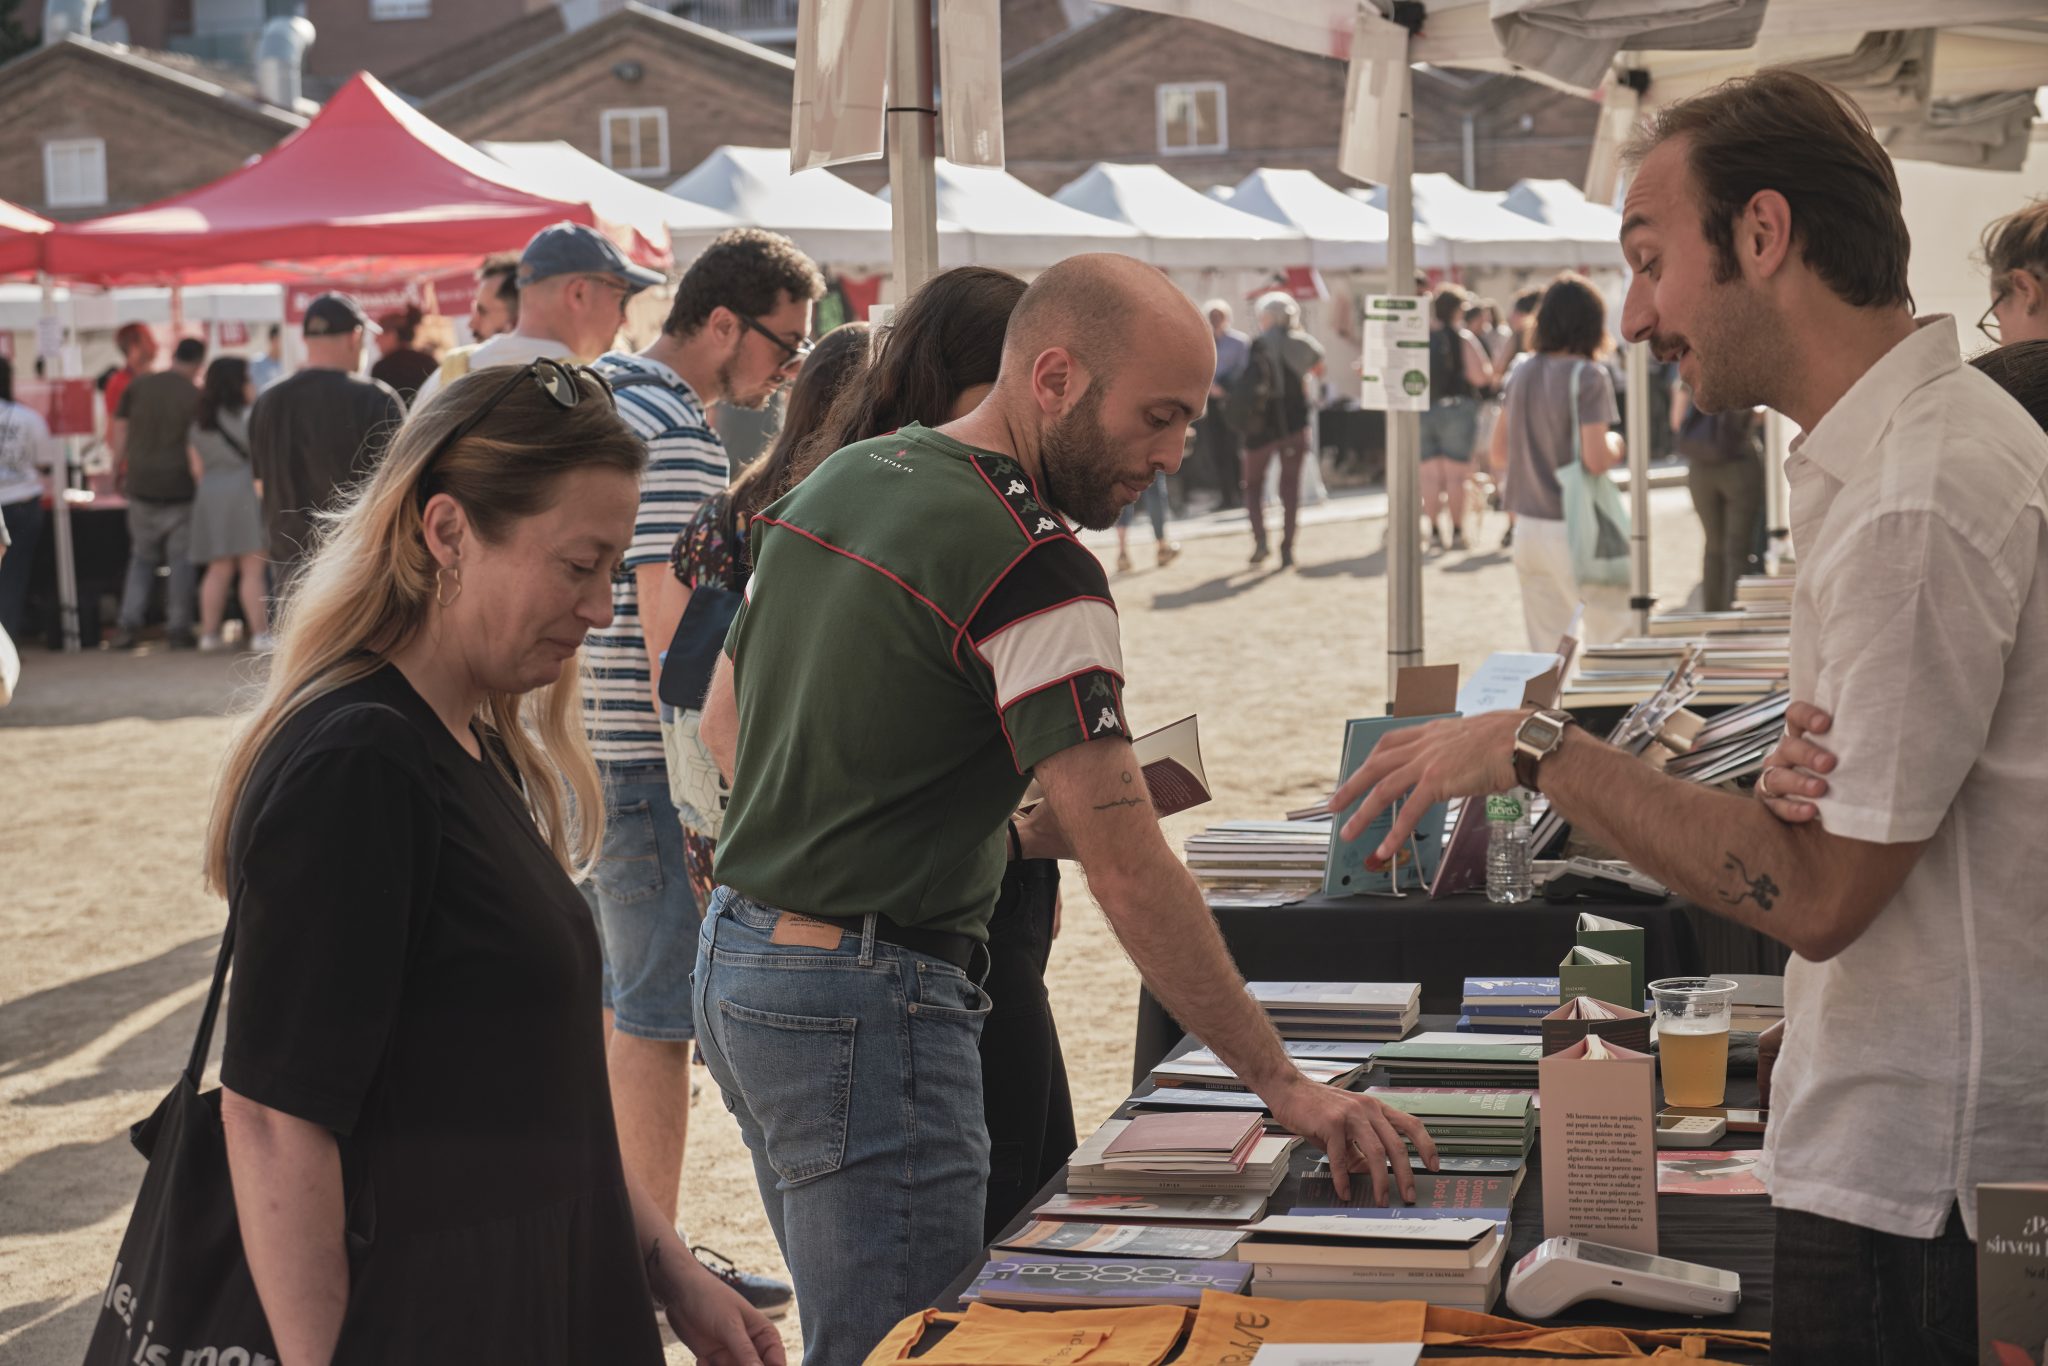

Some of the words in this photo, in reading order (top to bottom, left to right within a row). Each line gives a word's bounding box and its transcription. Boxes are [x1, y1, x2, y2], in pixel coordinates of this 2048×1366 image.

[884, 459, 902, 468] STAR
[1433, 1179, 1451, 1199] José
[1469, 1180, 1485, 1208] conste
[1488, 1180, 1503, 1190] La
[1985, 1234, 2041, 1256] sirven
[180, 1345, 277, 1366] mor
